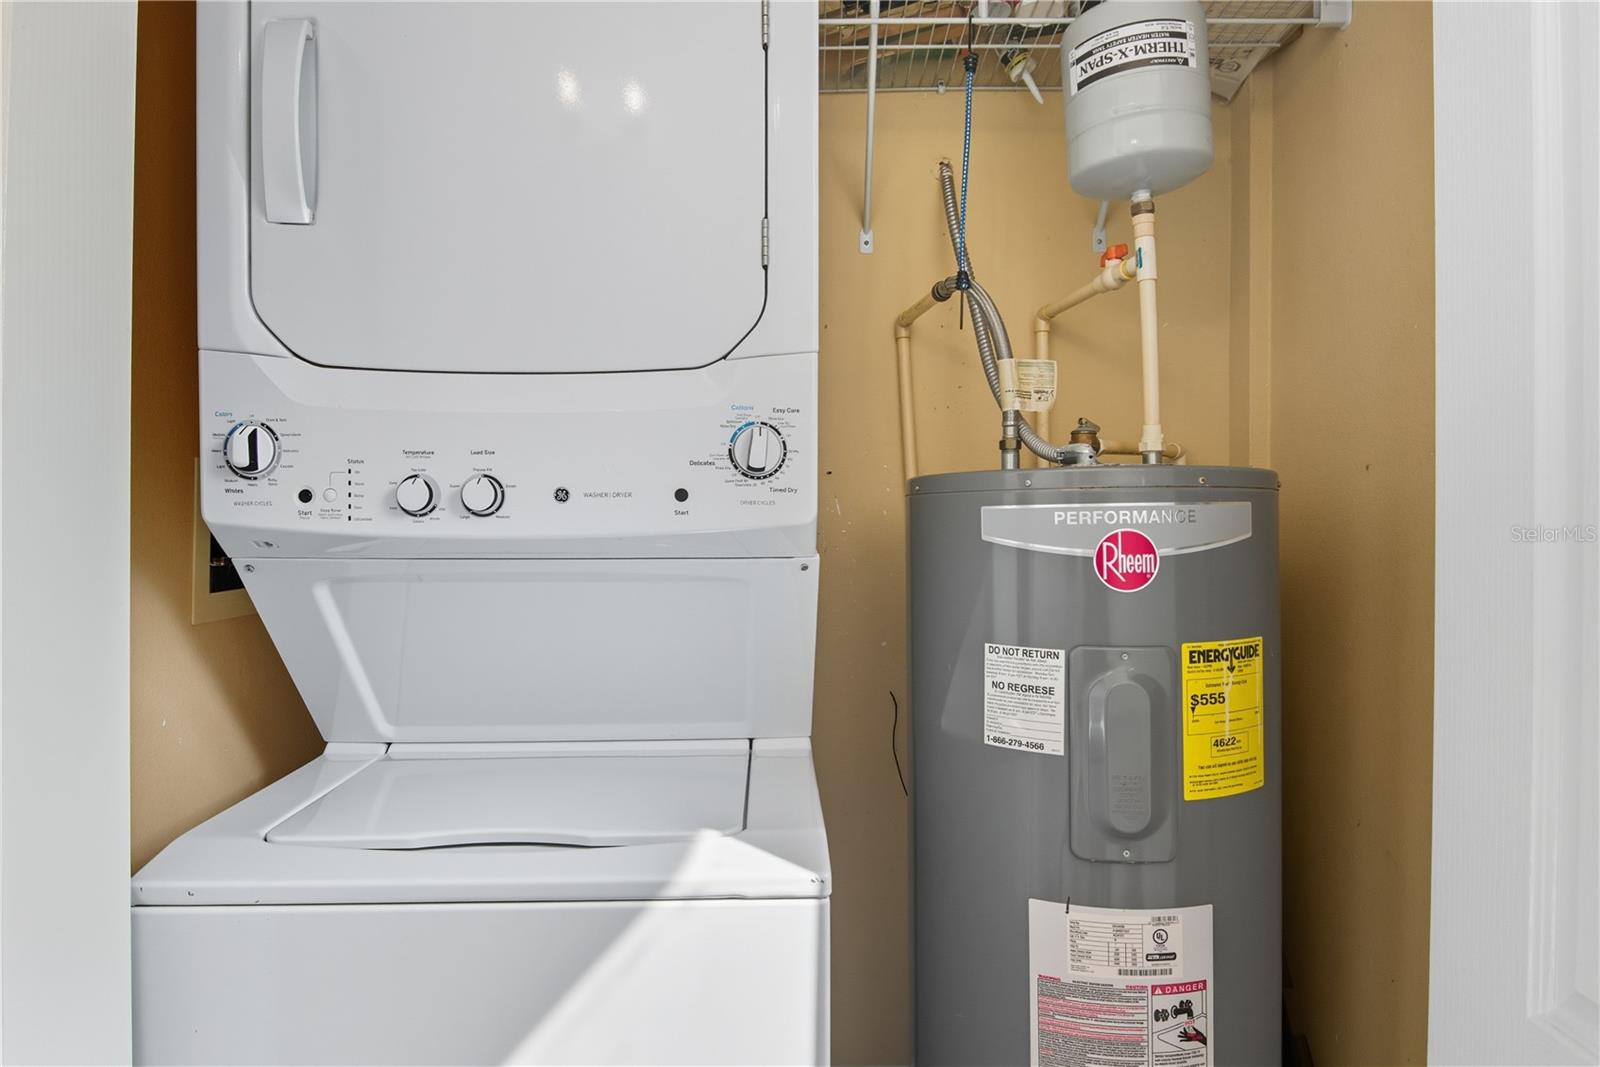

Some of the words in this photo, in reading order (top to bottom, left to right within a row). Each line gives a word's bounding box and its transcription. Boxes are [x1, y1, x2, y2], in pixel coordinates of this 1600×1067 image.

[1127, 32, 1150, 42] HEATER
[1078, 40, 1187, 78] THERM-X-SPAN
[1054, 509, 1197, 526] PERFORMANCE
[1103, 530, 1155, 582] Rheem
[988, 646, 1000, 654] DO
[1002, 647, 1020, 656] NOT
[1022, 649, 1060, 660] RETURN
[992, 680, 1005, 690] NO
[1007, 682, 1055, 696] REGRESE
[1190, 692, 1226, 706] $555
[1213, 736, 1236, 748] 4622
[1165, 983, 1204, 993] DANGER
